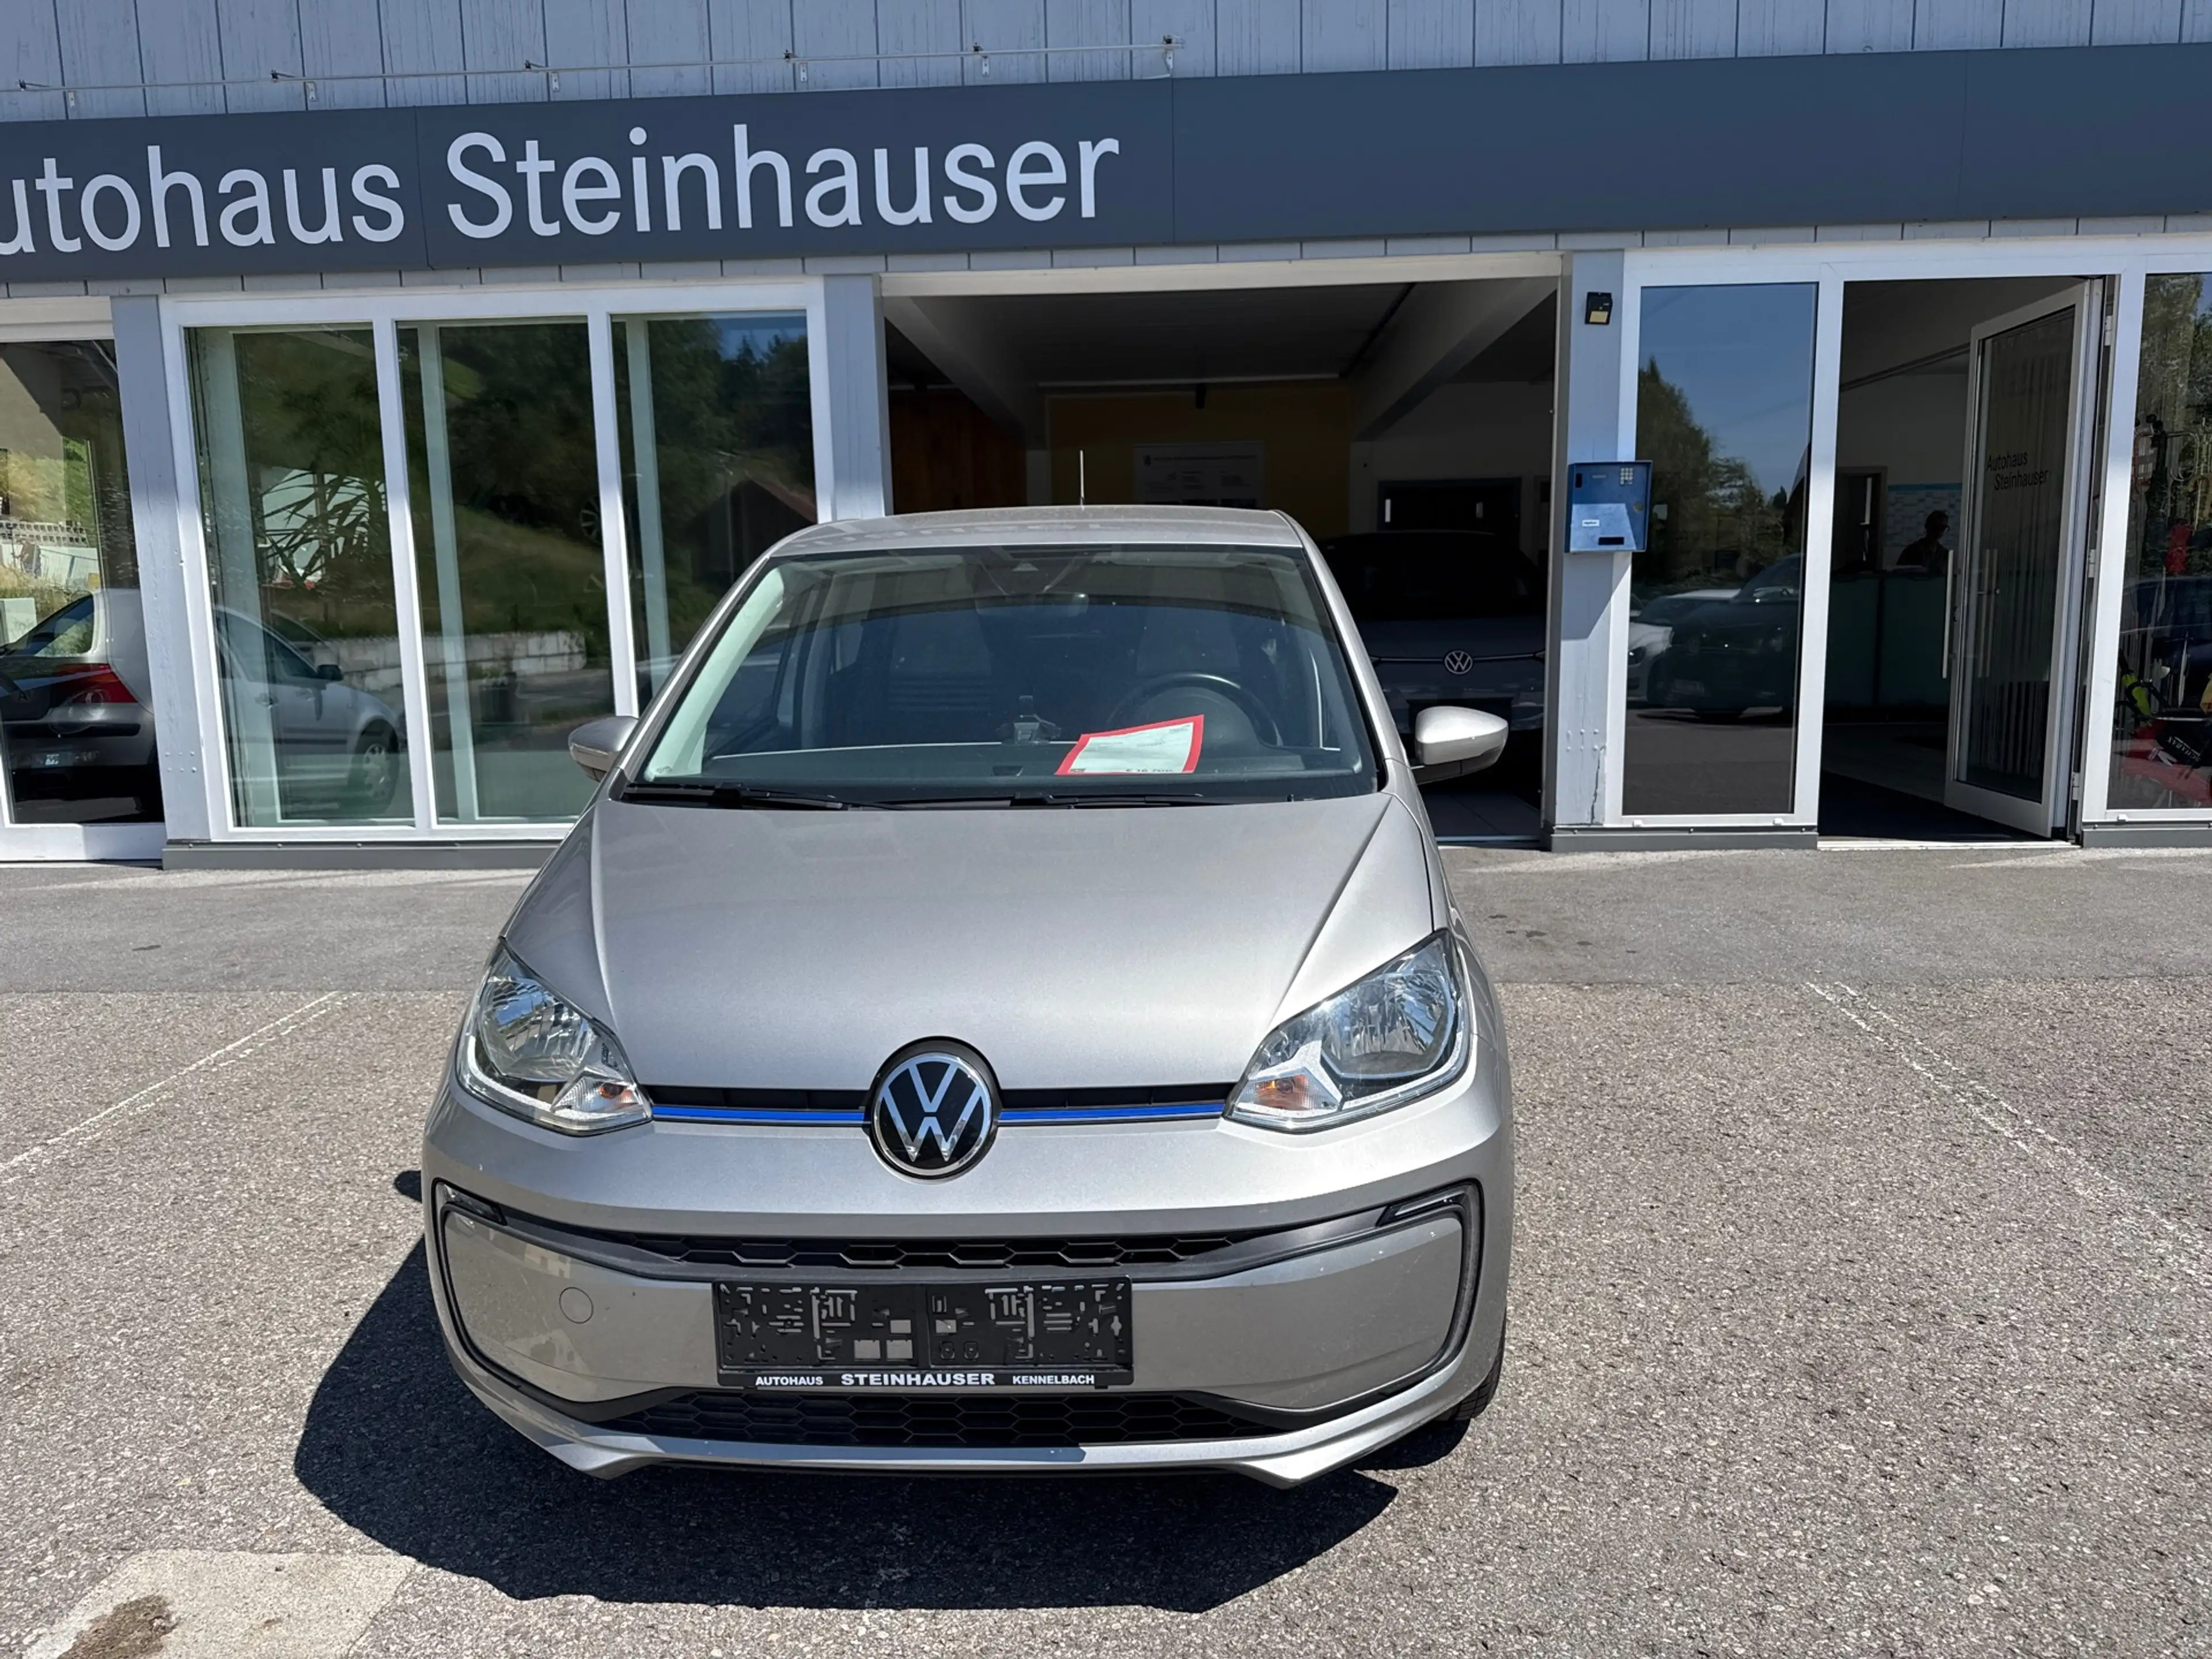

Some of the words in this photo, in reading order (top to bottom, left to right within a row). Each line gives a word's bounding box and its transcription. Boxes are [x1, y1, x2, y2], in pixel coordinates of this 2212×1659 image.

[447, 123, 1120, 239] Steinhauser
[1986, 450, 2028, 472] Autohaus
[1994, 469, 2049, 491] Steinhauser
[1445, 651, 1472, 673] VW
[875, 1052, 989, 1172] VW
[755, 1376, 824, 1387] AUTOHAUS
[840, 1373, 996, 1387] STEINHAUSER
[1012, 1374, 1095, 1385] KENNELBACH
